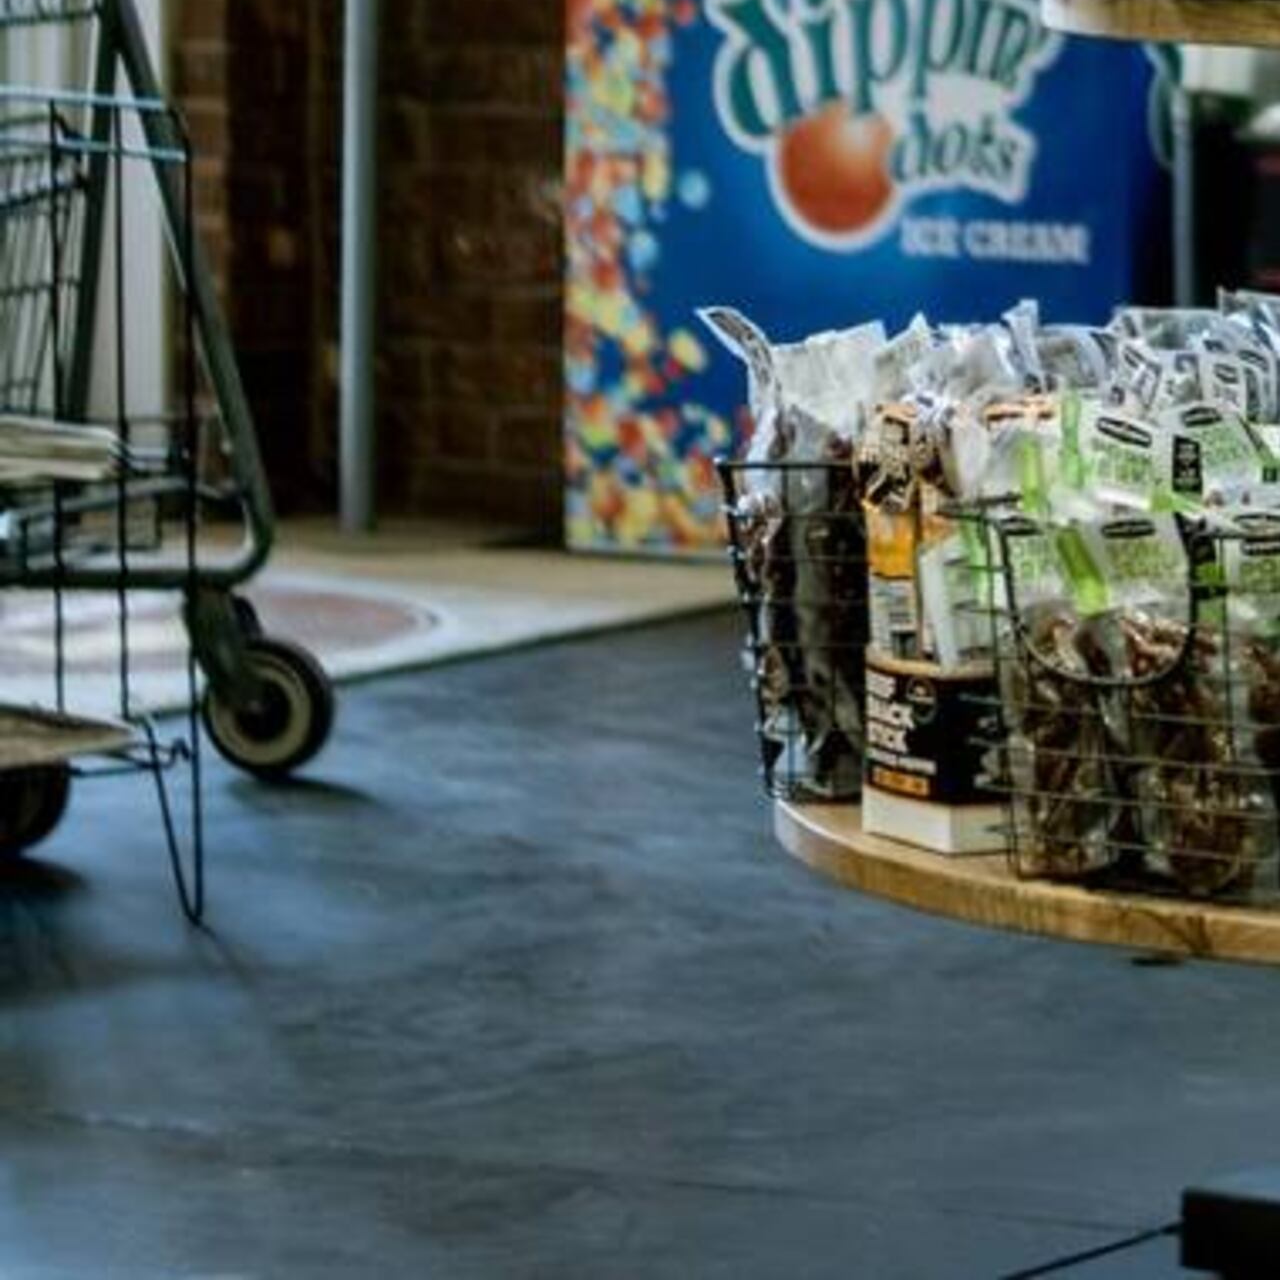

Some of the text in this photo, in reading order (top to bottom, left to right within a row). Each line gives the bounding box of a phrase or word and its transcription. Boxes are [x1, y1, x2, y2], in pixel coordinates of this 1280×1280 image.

[892, 107, 1019, 185] dots
[901, 215, 1091, 266] ICE CREAM
